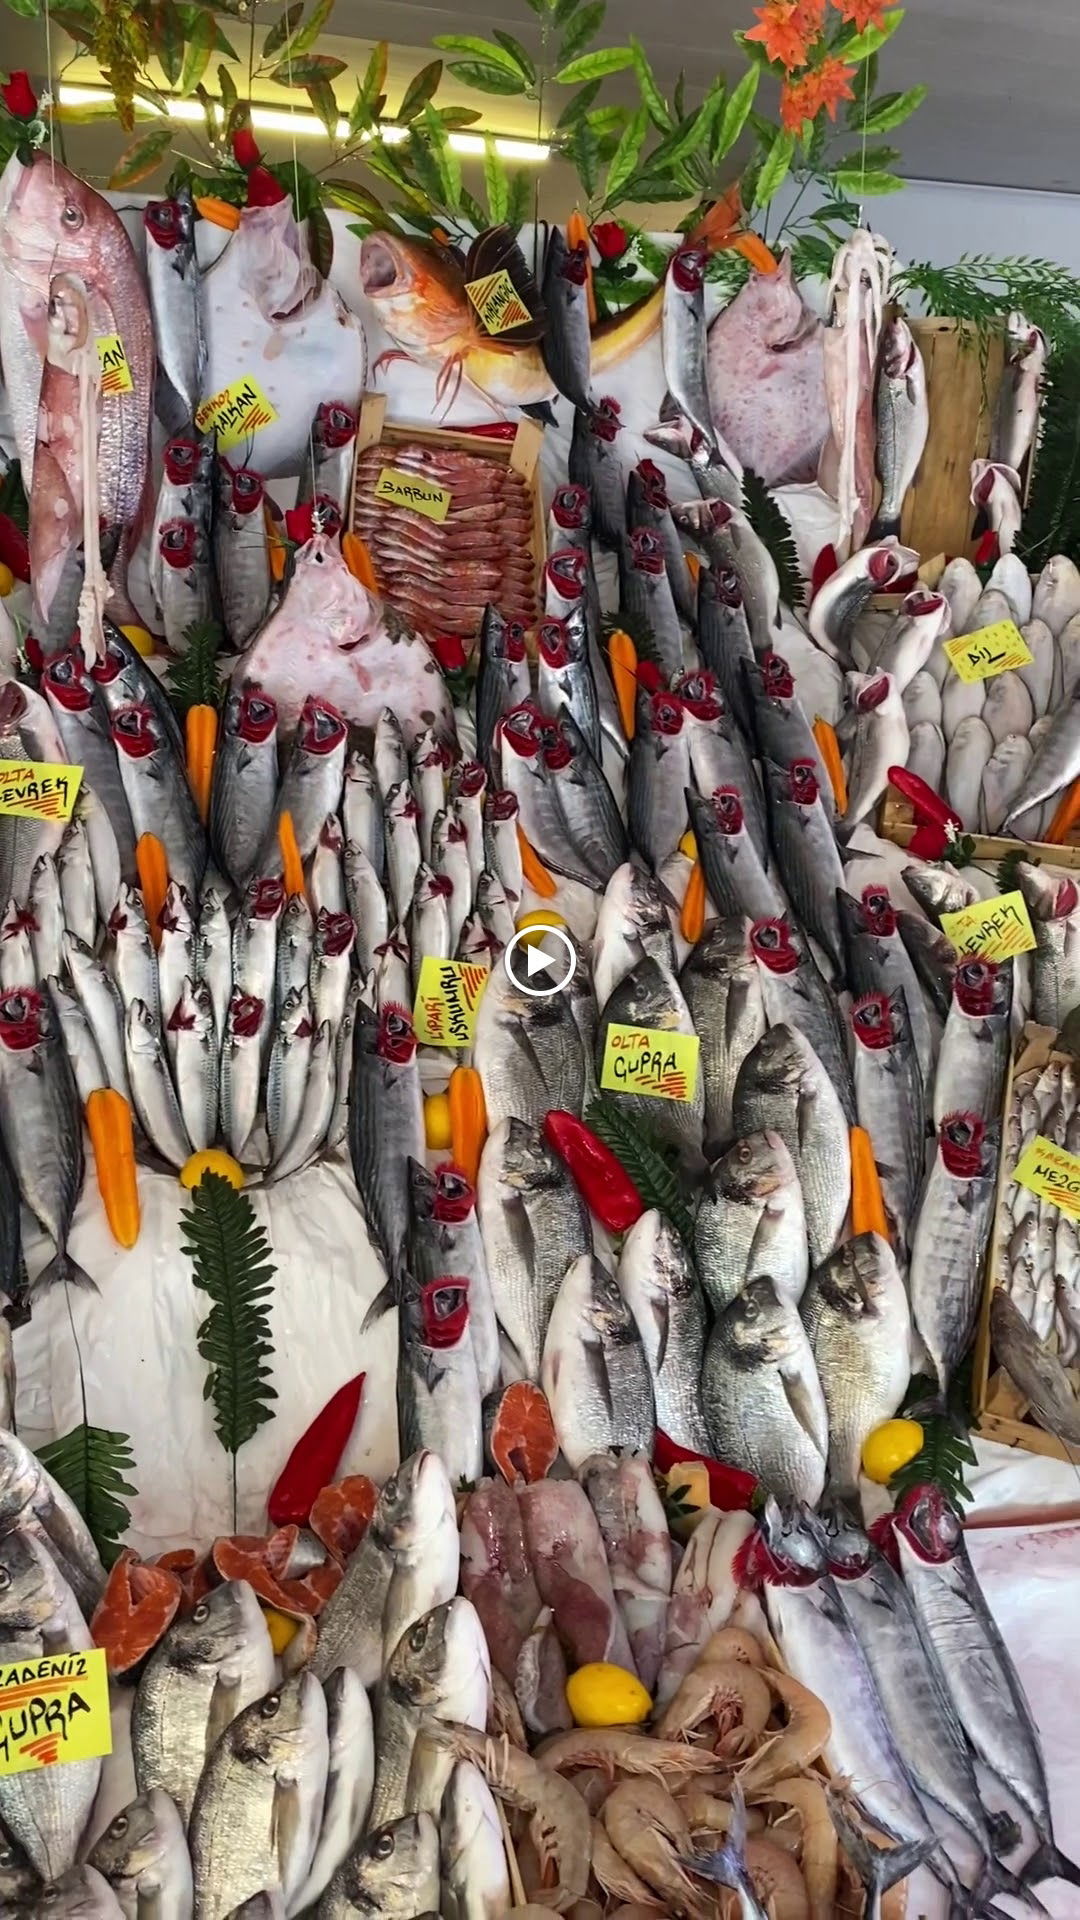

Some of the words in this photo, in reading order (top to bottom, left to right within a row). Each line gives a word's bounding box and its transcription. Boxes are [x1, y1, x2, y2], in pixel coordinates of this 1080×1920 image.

[209, 383, 257, 436] KALKAN
[378, 481, 443, 503] BARBUN
[958, 904, 1024, 956] LEVREK
[440, 967, 470, 1041] USKUMRU
[611, 1033, 650, 1050] OLTA
